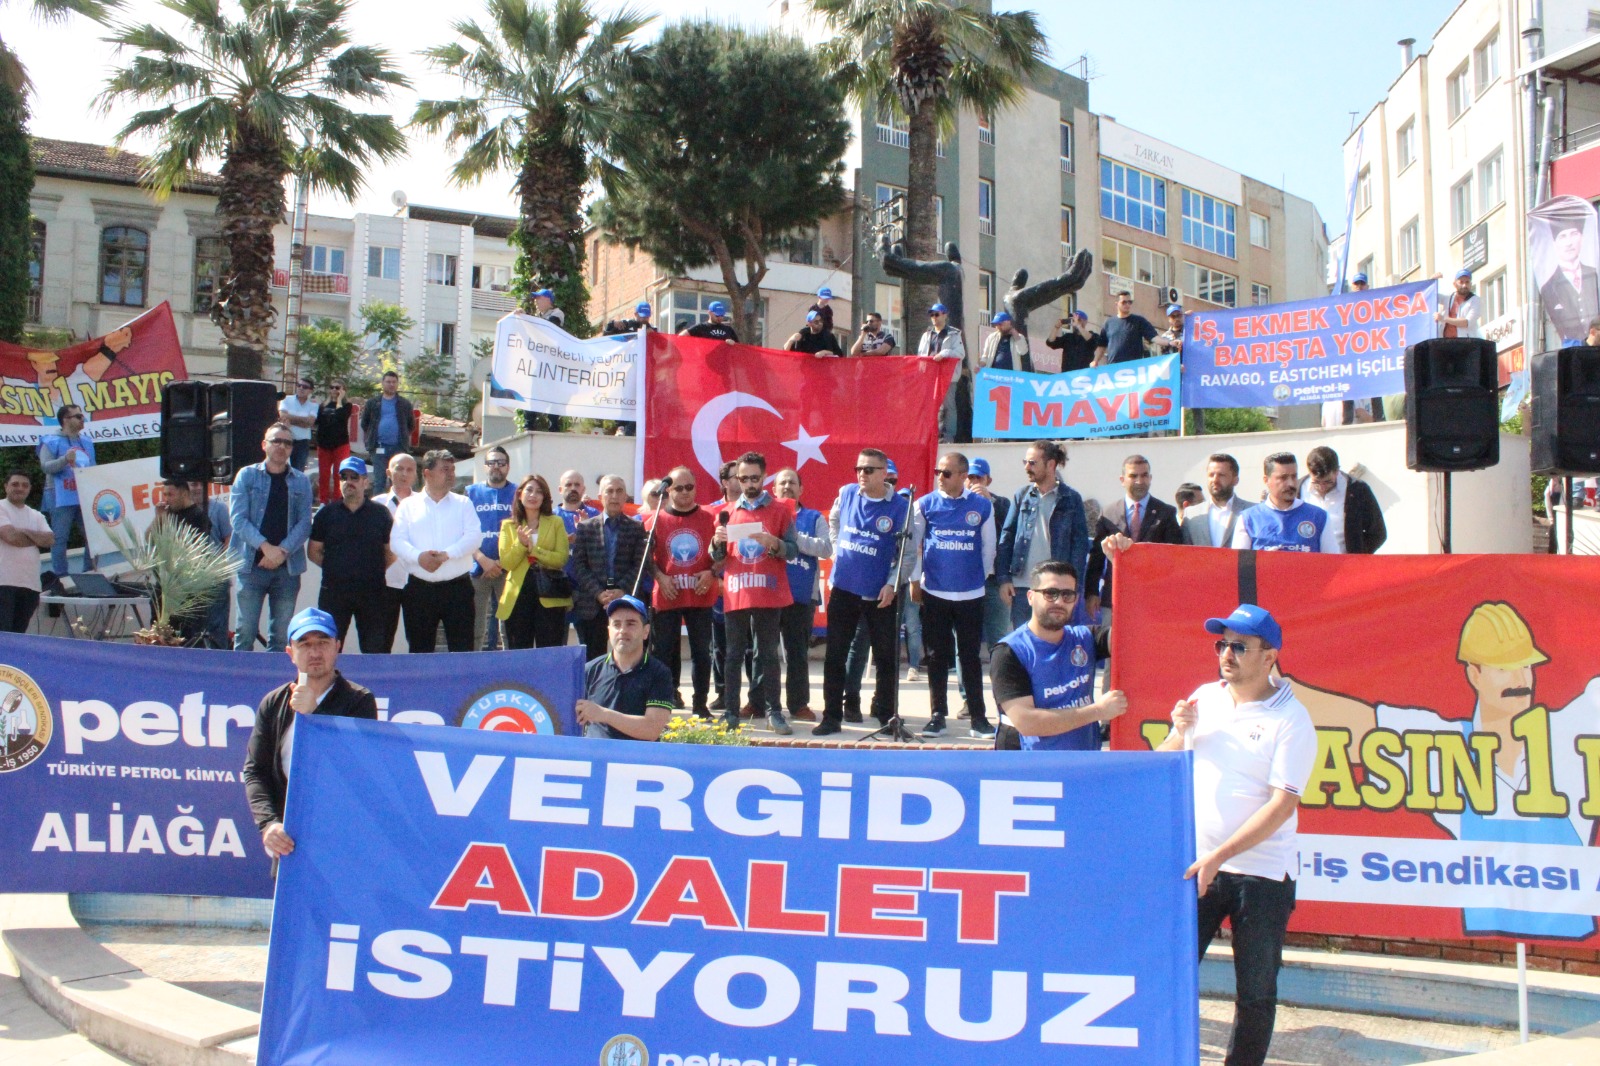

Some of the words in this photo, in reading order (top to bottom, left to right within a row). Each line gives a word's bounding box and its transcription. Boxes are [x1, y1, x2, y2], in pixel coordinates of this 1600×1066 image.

[1134, 144, 1174, 168] TARKAN
[1233, 306, 1330, 339] EKMEK
[1336, 291, 1429, 326] YOKSA
[507, 334, 522, 348] En
[528, 338, 584, 362] bereketli
[1214, 336, 1327, 368] BARIŞTA
[1333, 326, 1389, 356] YOK
[516, 358, 626, 388] ALINTERİDİR
[1030, 360, 1171, 399] YAŞASIN
[1201, 371, 1265, 387] RAVAGO,
[1270, 363, 1352, 384] EASTCHEM
[1357, 355, 1405, 377] İŞÇİLE
[52, 376, 73, 405] 1
[989, 385, 1012, 431] 1
[1023, 387, 1173, 427] MAYIS
[1090, 423, 1130, 433] RAVAGO
[476, 503, 513, 512] GÖREVL
[935, 541, 974, 550] SENDİKASI
[18, 744, 39, 763] 1950
[47, 760, 116, 778] TÜRKİYE
[121, 765, 181, 780] PETROL
[186, 766, 235, 783] KİMYA
[32, 802, 247, 858] ALİAĞA
[1361, 852, 1580, 892] Sendikası
[429, 841, 1030, 945] ADALET
